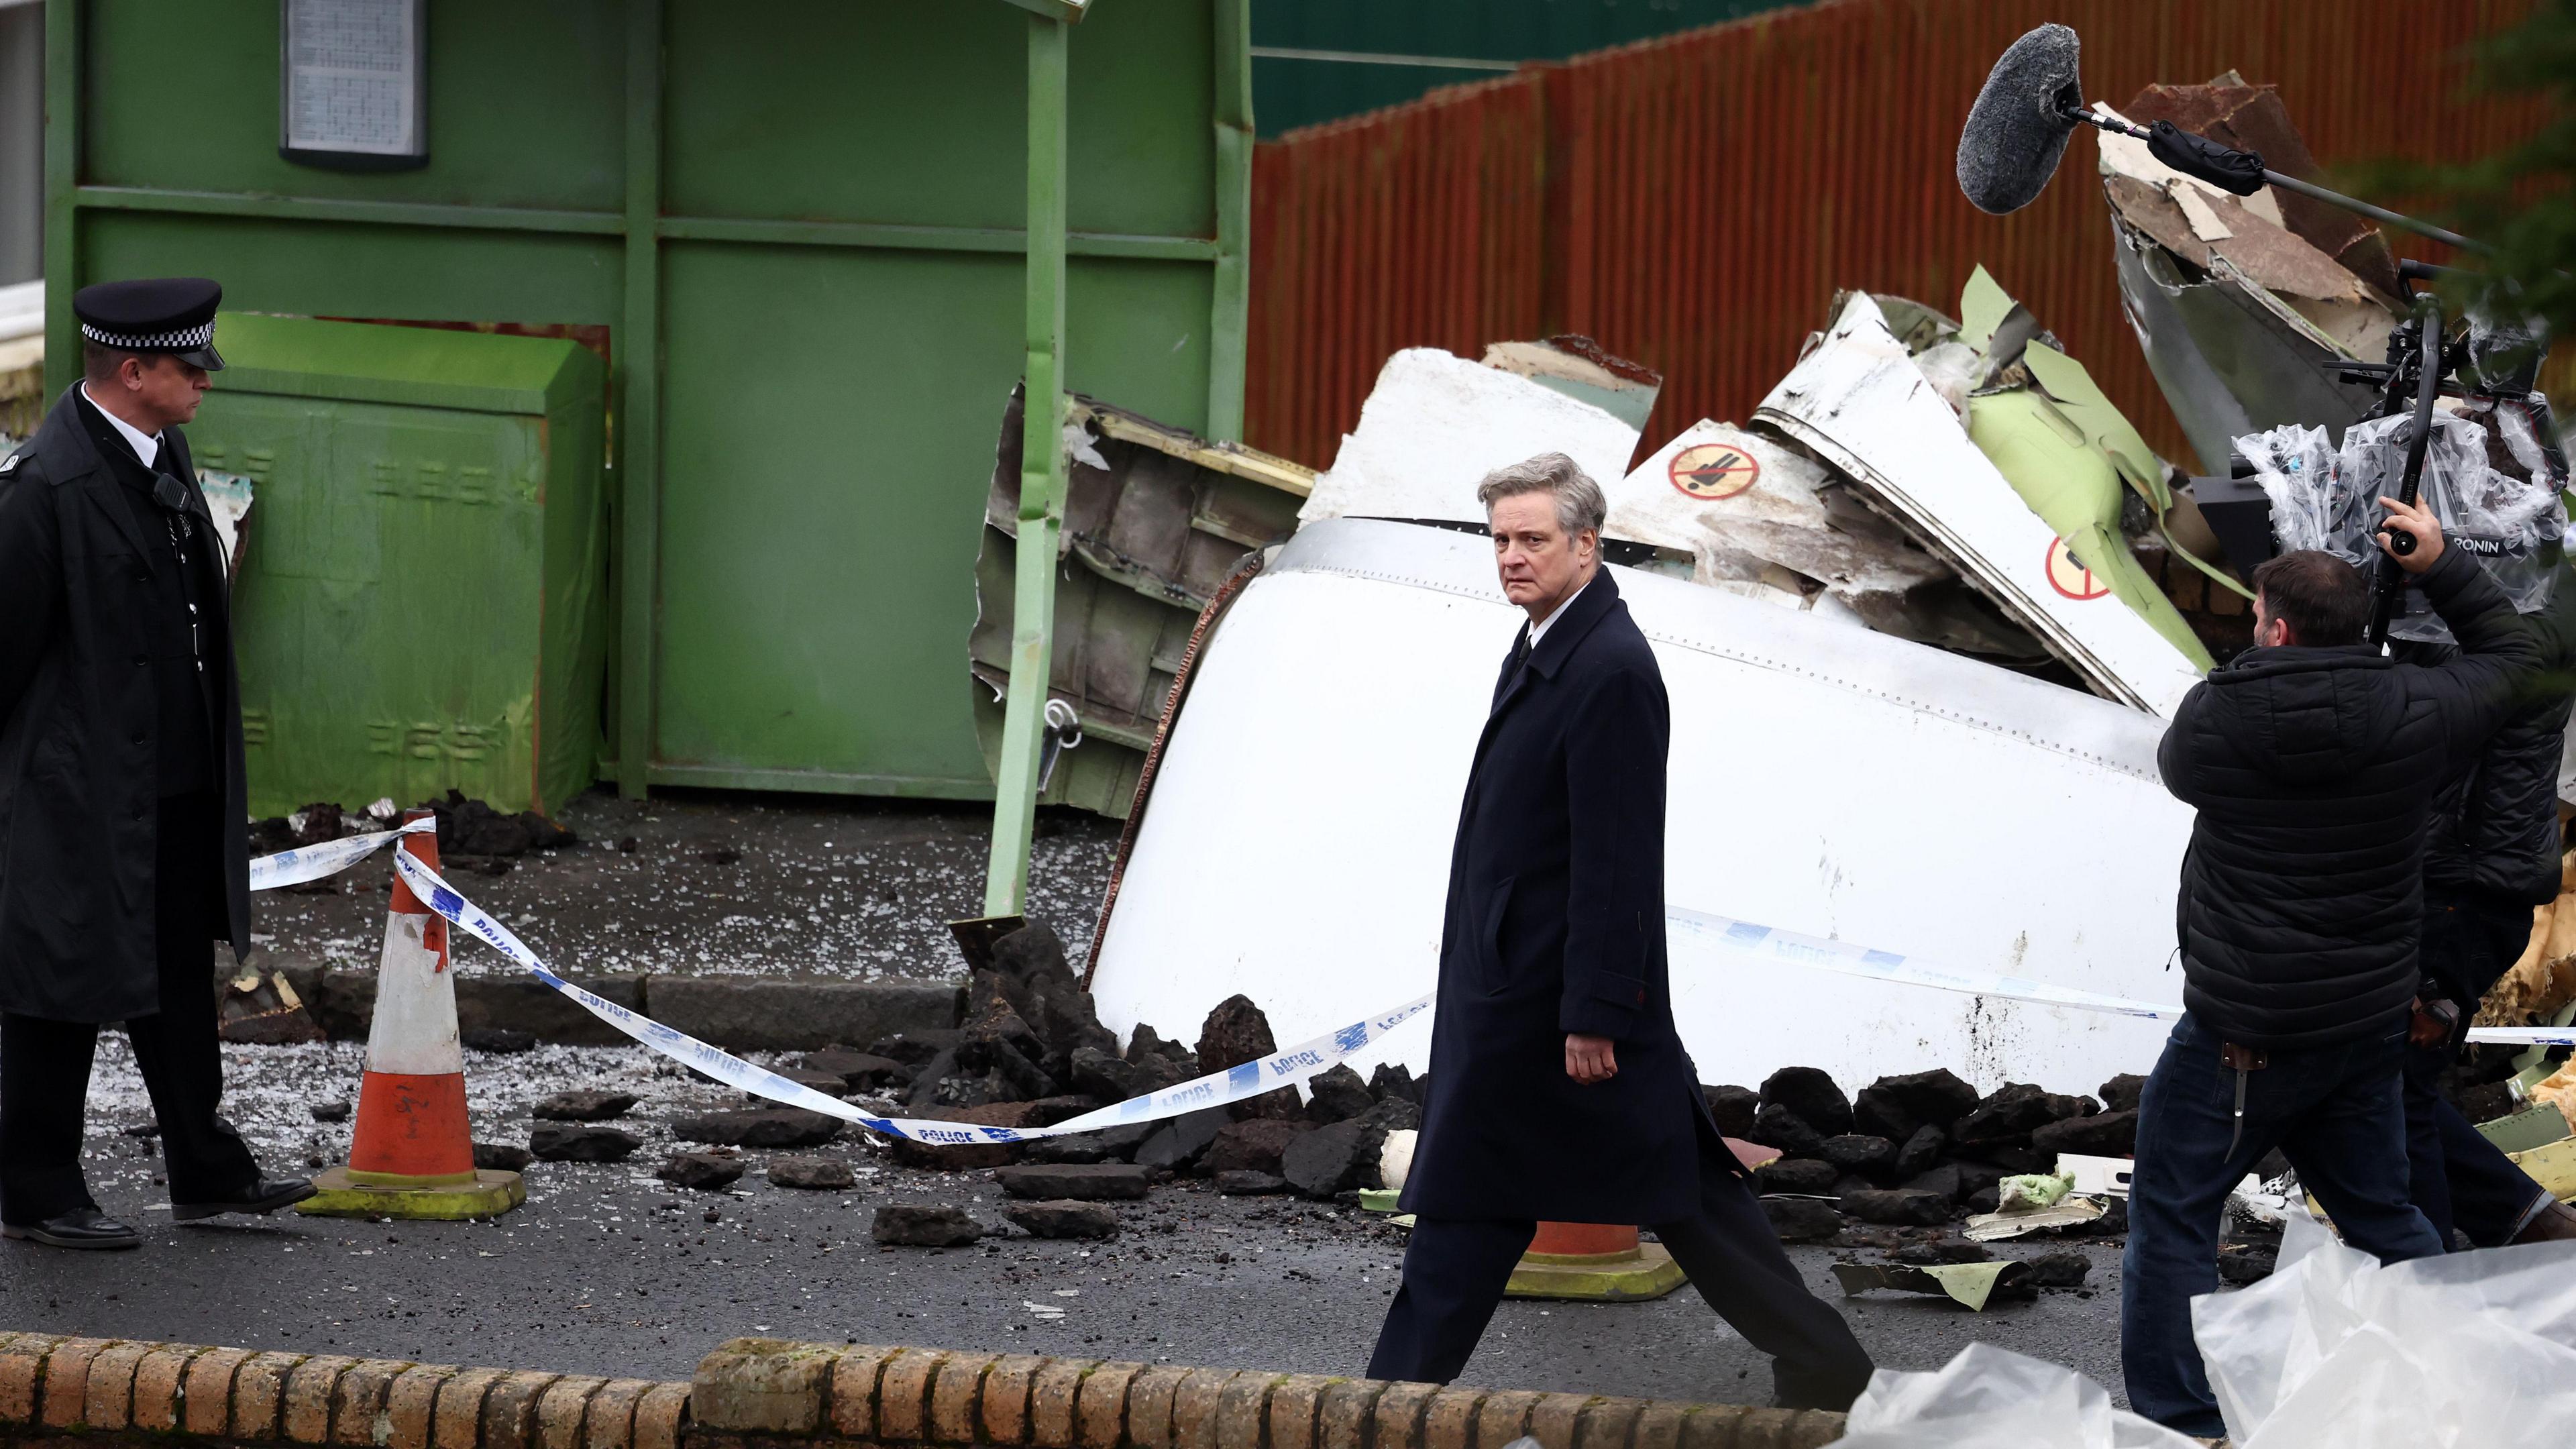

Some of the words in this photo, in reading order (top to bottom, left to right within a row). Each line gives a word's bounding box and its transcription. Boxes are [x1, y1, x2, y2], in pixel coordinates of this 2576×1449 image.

[2454, 537, 2500, 553] RONIN
[472, 918, 520, 959] POIC
[917, 1129, 976, 1143] POLICE
